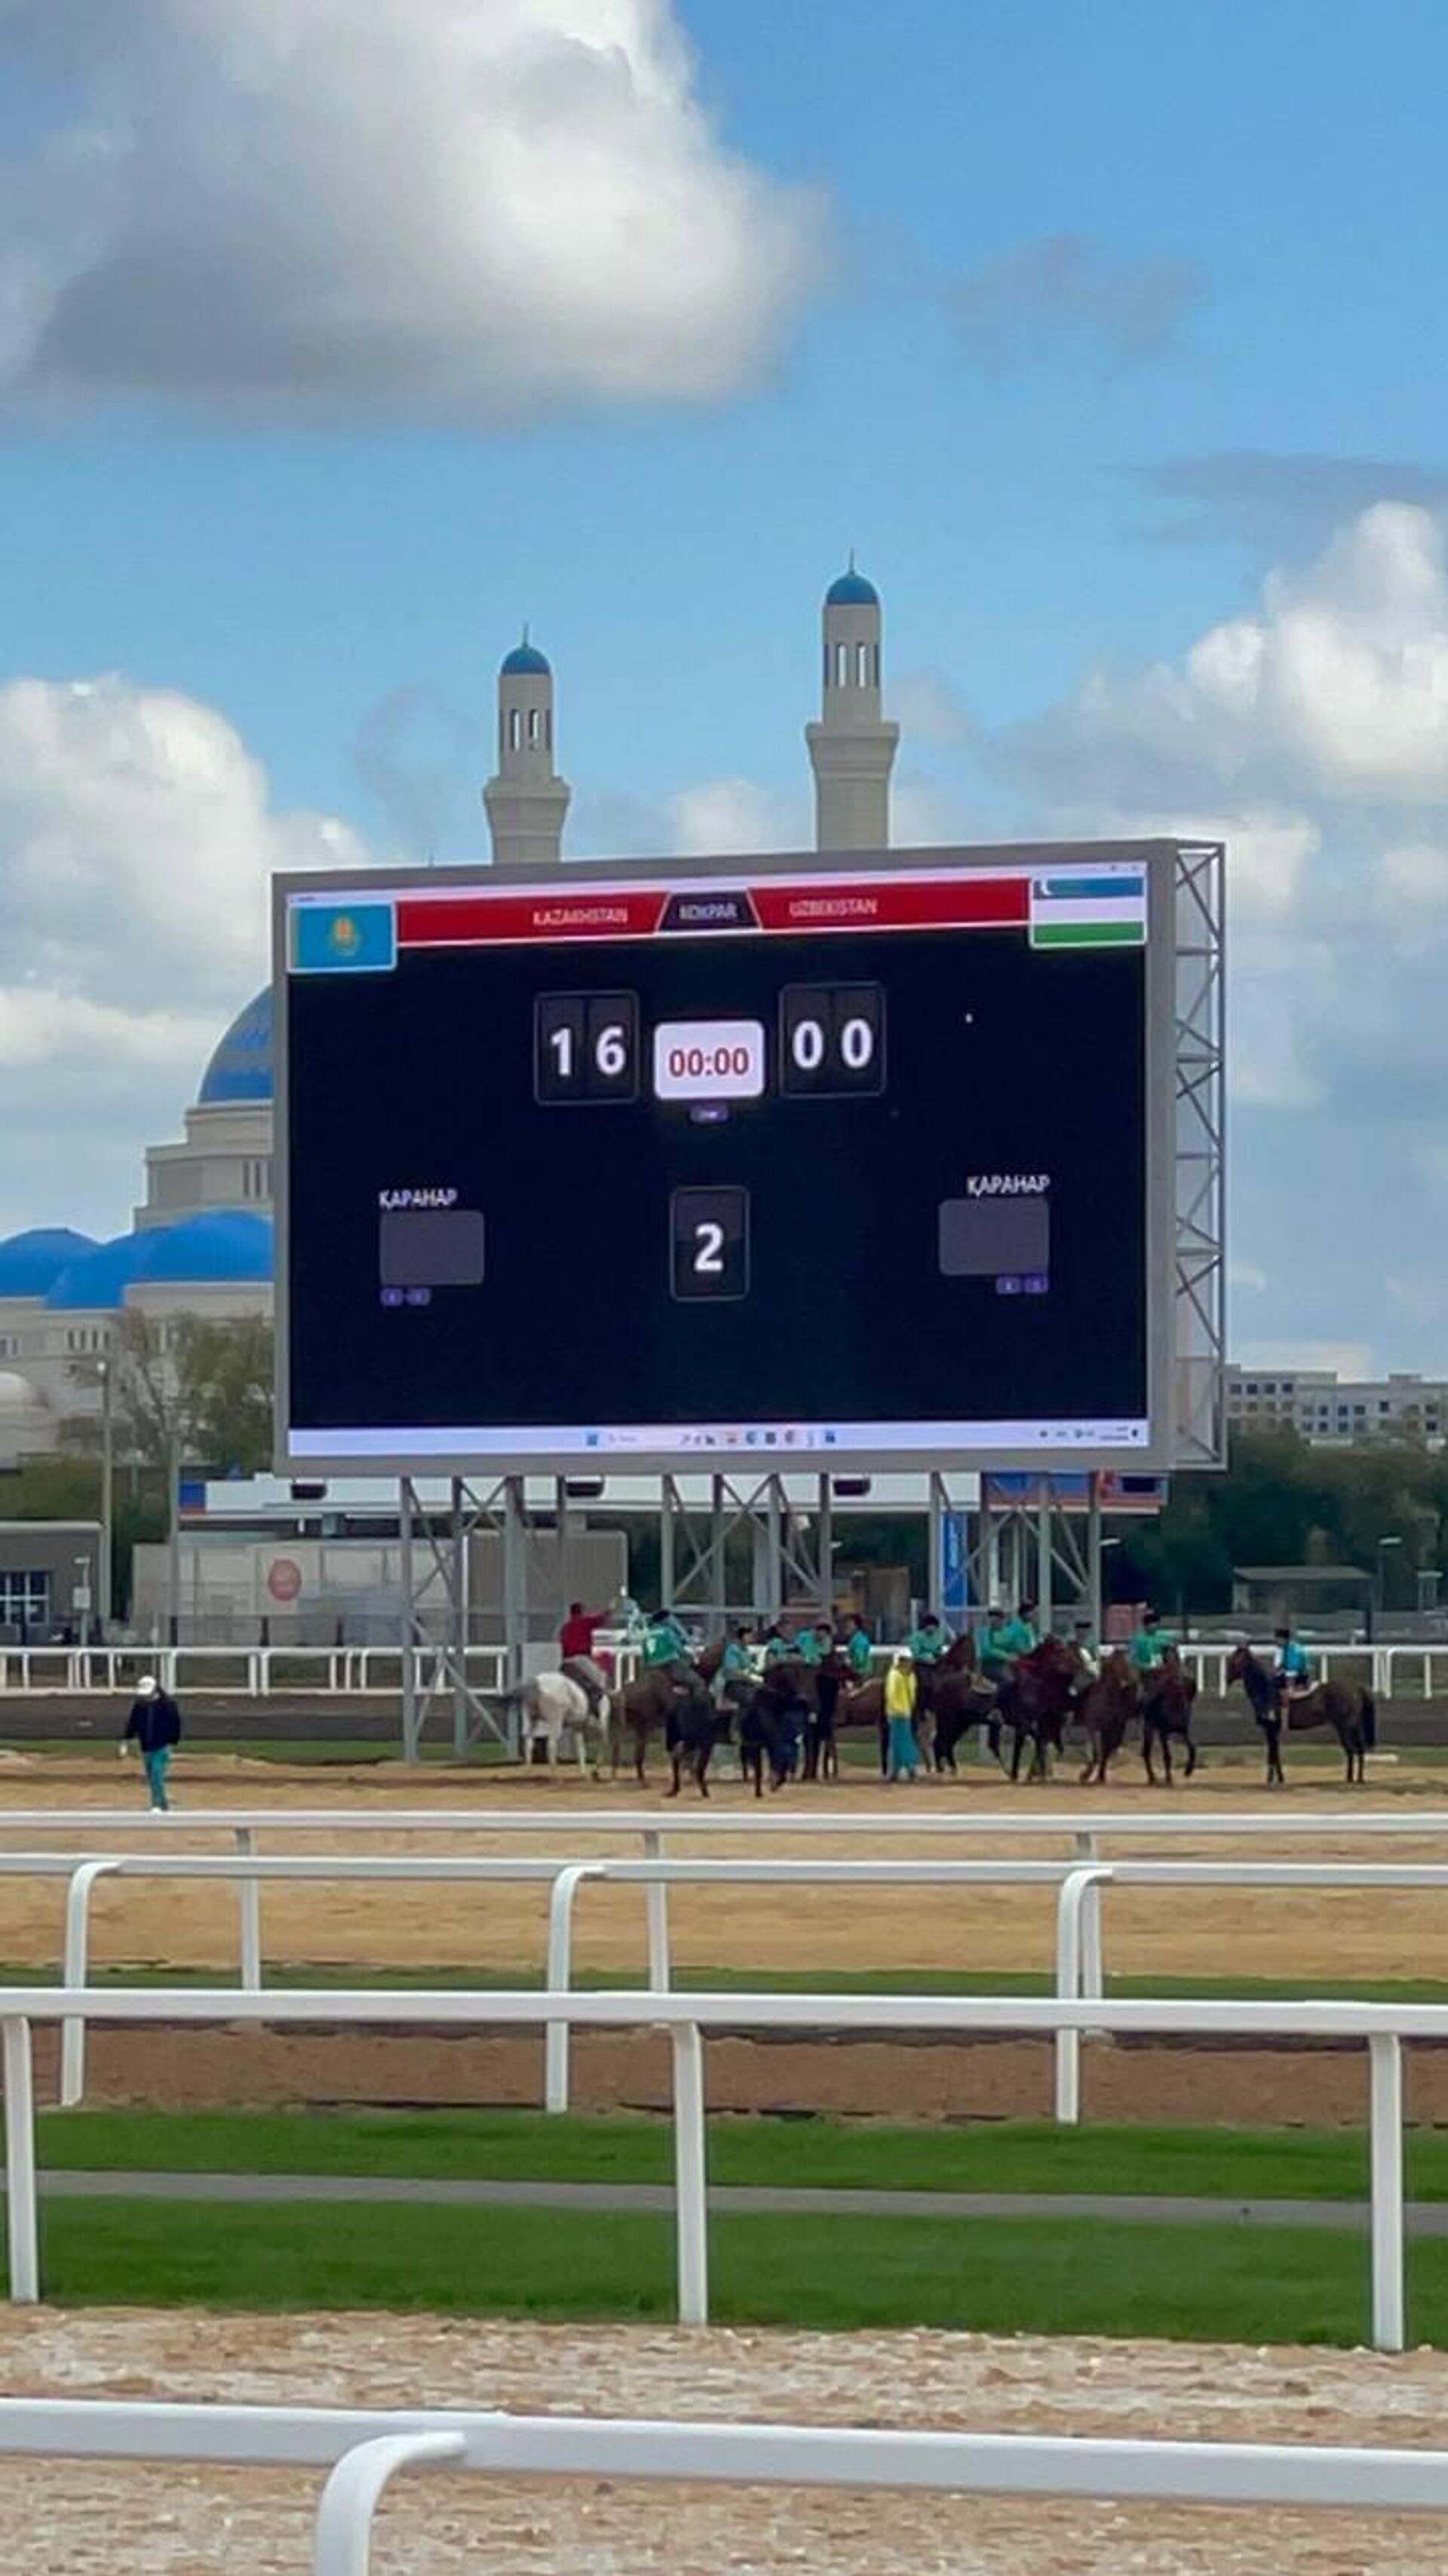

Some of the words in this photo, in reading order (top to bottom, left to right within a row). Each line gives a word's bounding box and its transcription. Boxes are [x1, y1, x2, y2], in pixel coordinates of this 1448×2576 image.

[532, 907, 627, 926] KAZAKHSTAN
[680, 902, 738, 920] KOKPAR
[789, 898, 878, 917] UZBEKISTAN
[669, 1047, 750, 1078] 00:00
[695, 1222, 724, 1272] 2
